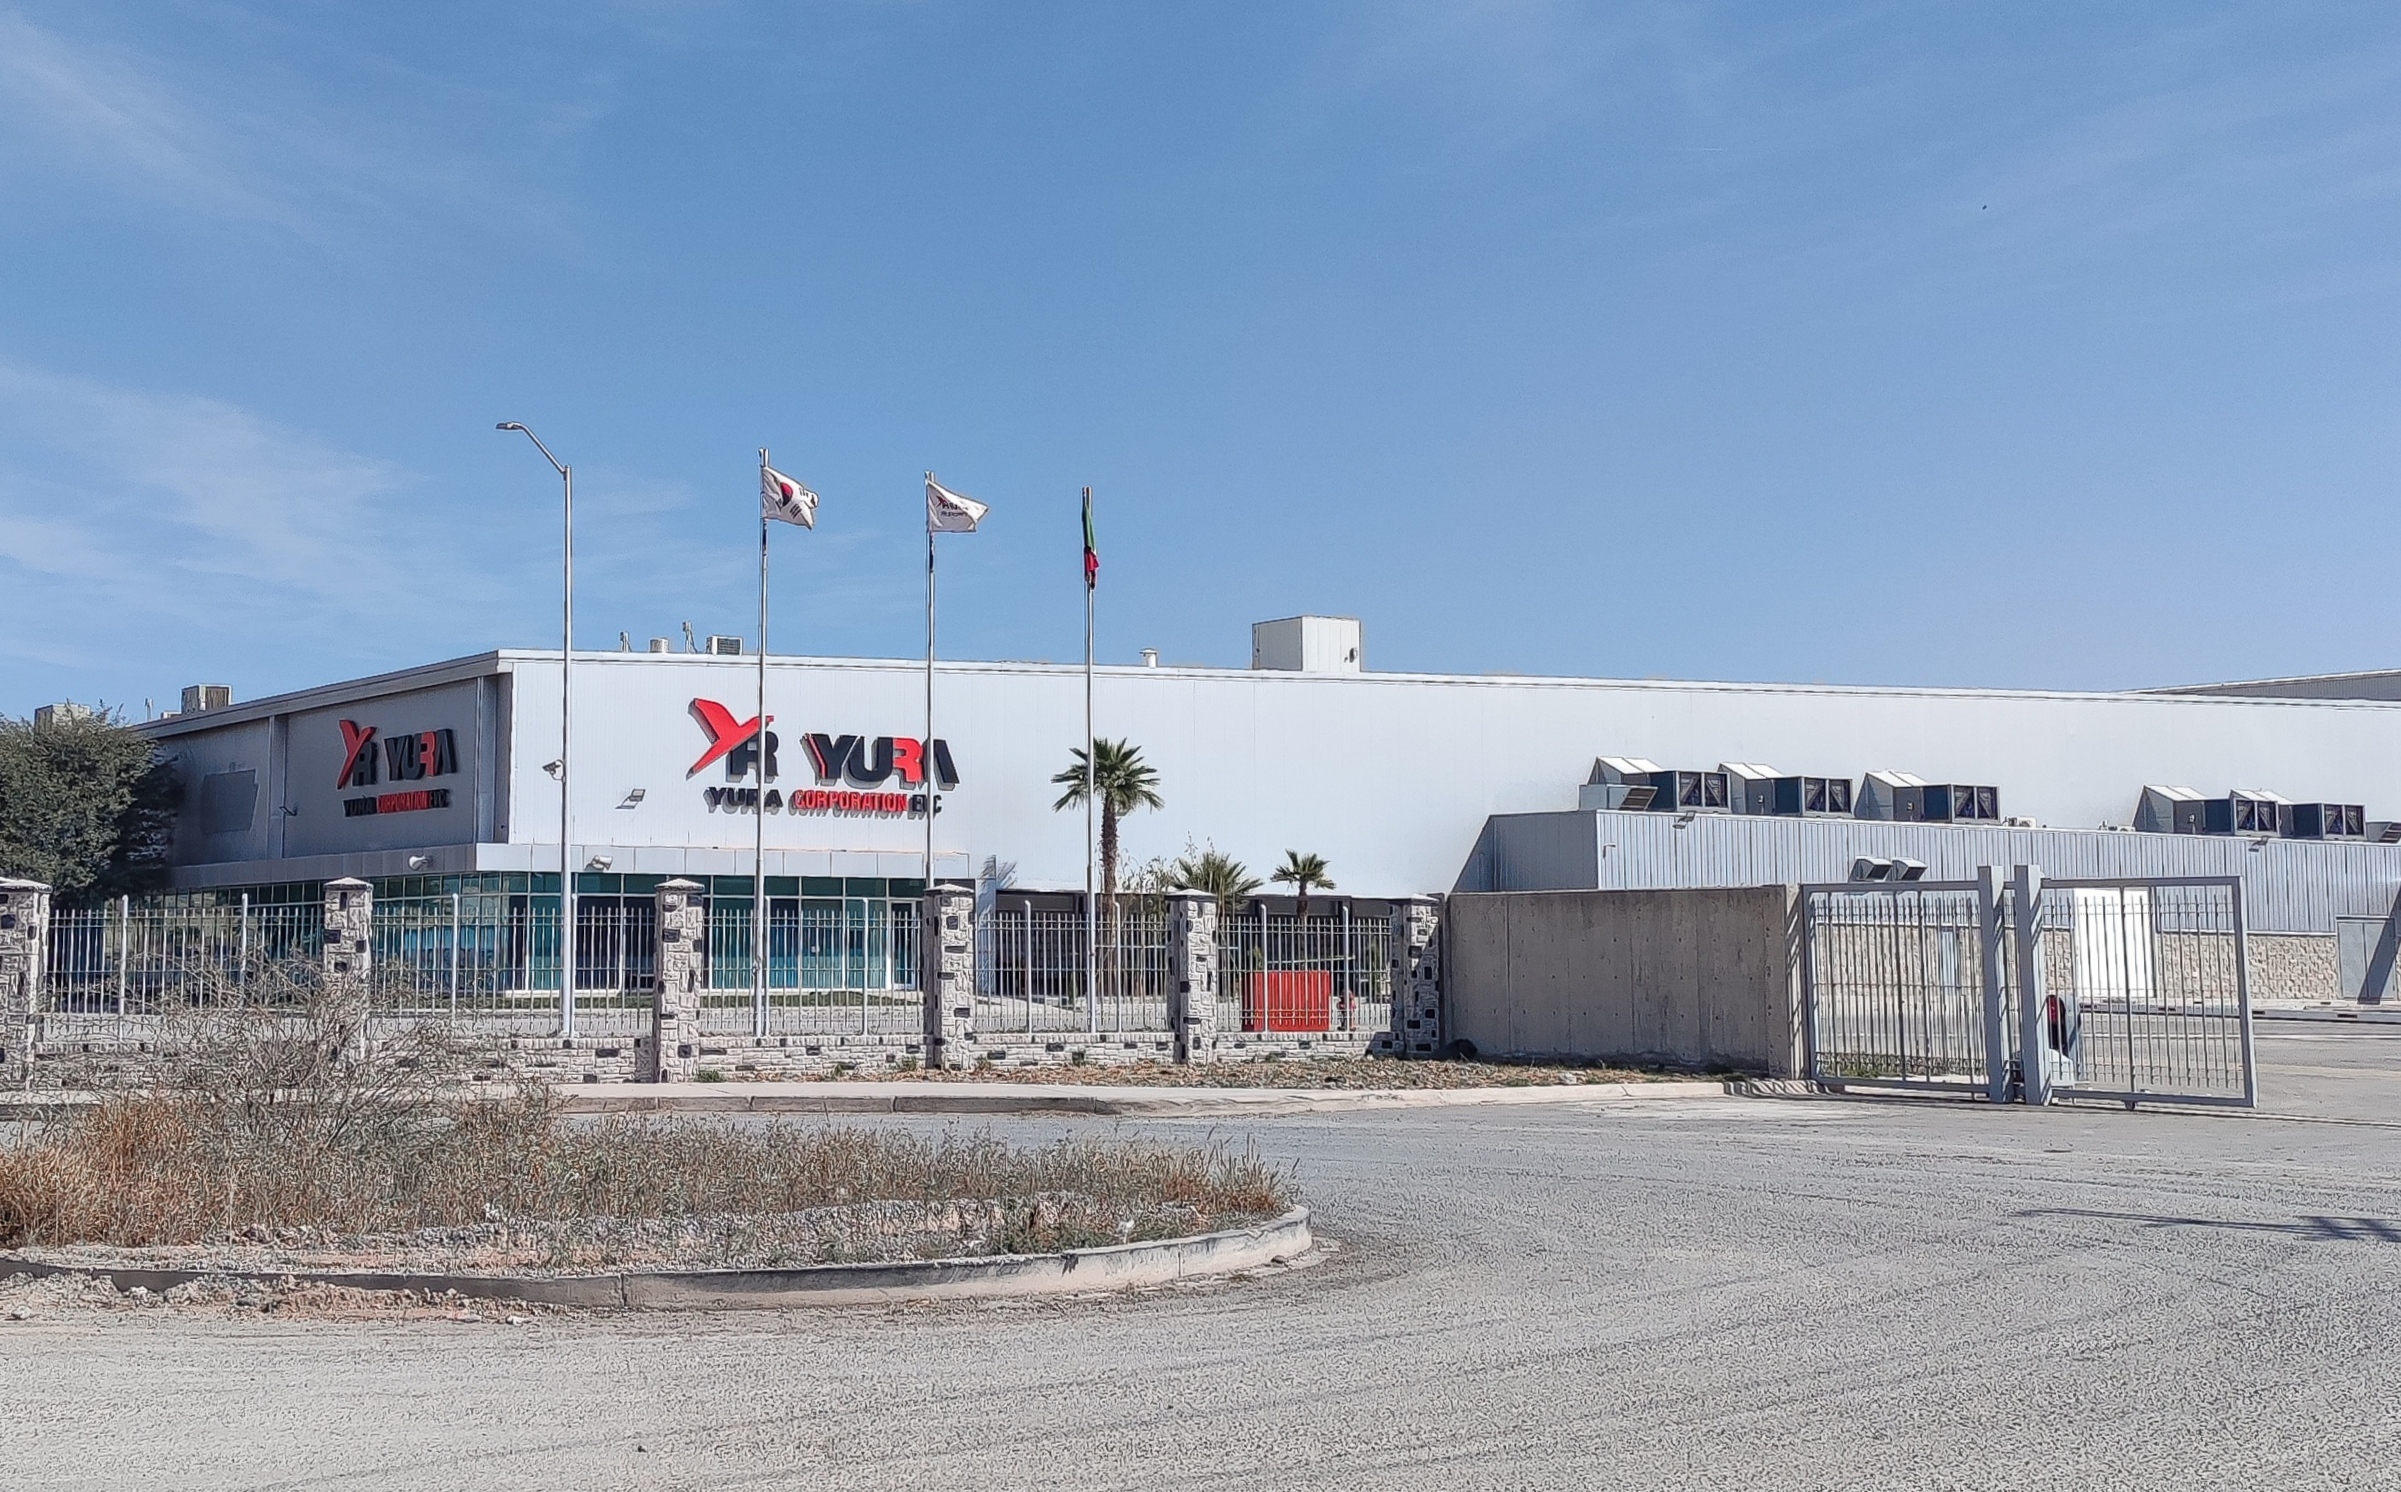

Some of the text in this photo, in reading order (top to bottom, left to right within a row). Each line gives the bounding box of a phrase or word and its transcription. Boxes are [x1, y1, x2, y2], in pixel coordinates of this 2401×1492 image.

[384, 729, 457, 781] YURA
[378, 791, 429, 813] CORPORATION
[704, 787, 783, 808] YURA
[792, 790, 909, 812] CORPORATION
